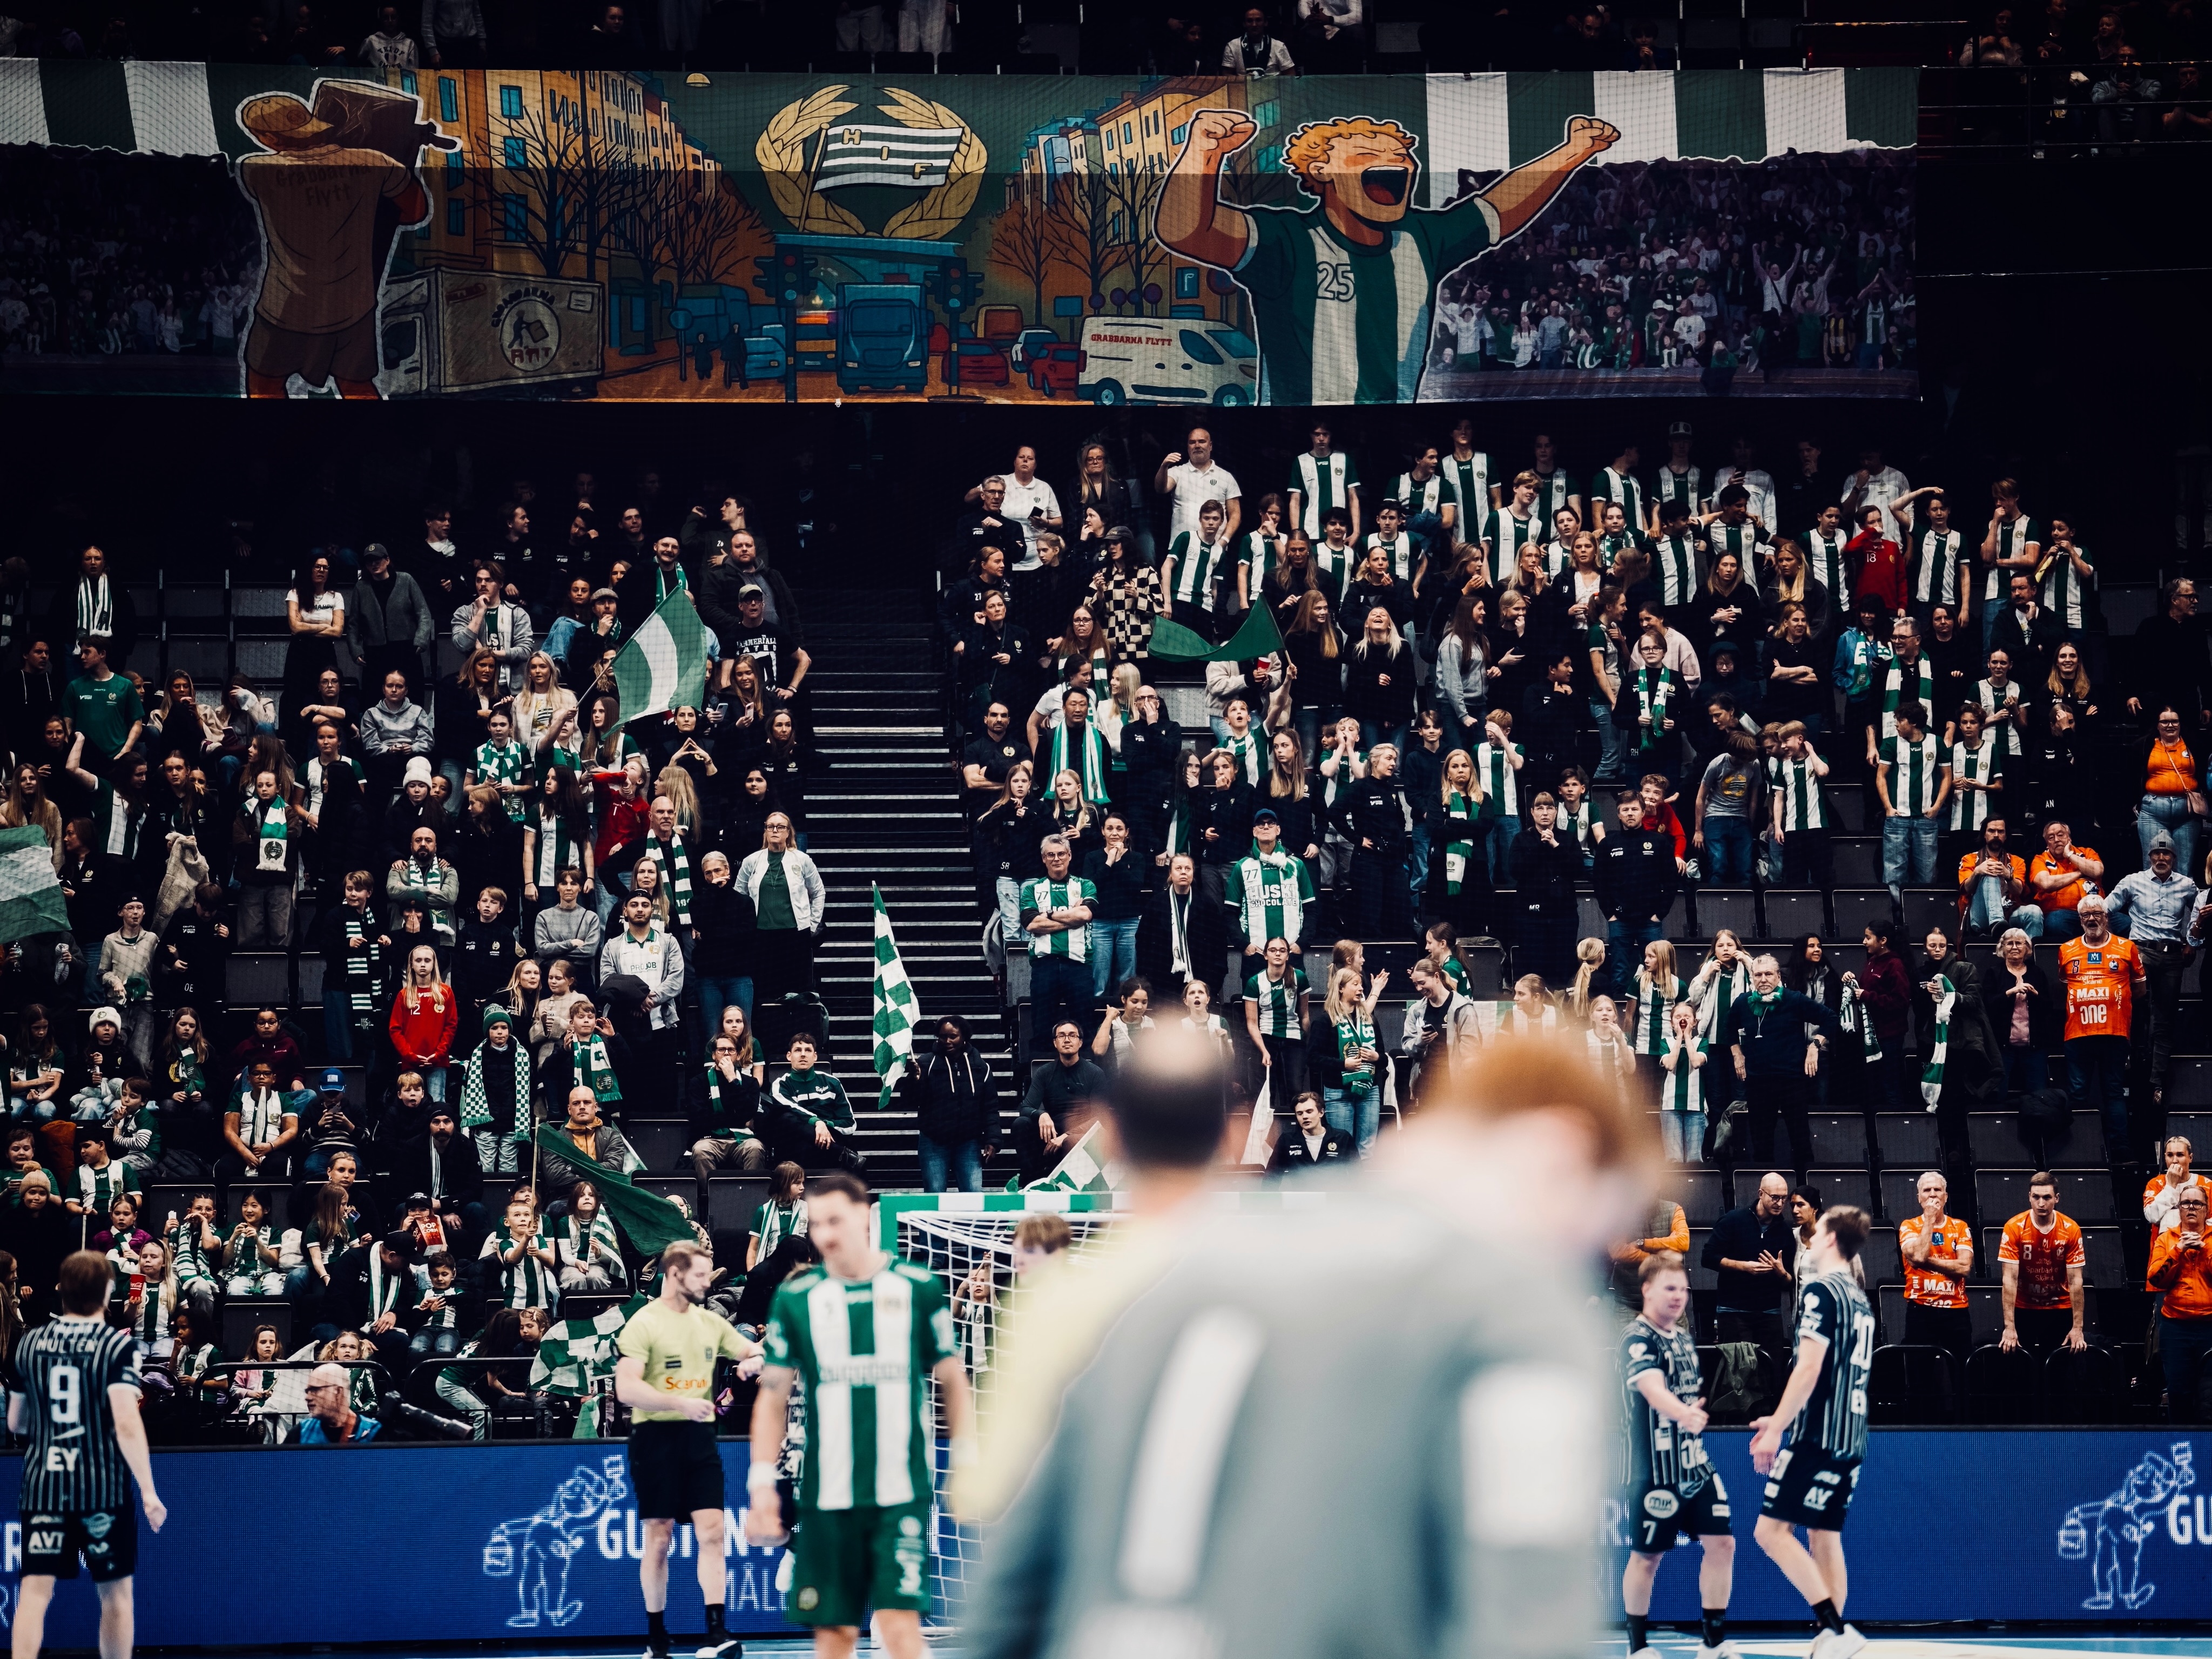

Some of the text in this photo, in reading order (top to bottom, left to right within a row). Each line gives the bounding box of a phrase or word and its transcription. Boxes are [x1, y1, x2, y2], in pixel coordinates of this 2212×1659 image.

[377, 45, 405, 56] TEDDY
[1316, 261, 1355, 302] 25
[1090, 333, 1172, 347] GRABBARNA FLYTT
[1866, 553, 1876, 563] 18
[974, 592, 982, 601] 27
[1630, 748, 1638, 757] RH
[2045, 799, 2054, 808] AN
[1244, 868, 1258, 880] 77
[1036, 891, 1048, 901] 77
[1246, 883, 1297, 899] HUSKI
[1250, 899, 1297, 907] CHOCOLATE
[630, 962, 657, 971] PROJOB
[2072, 959, 2080, 974] 8
[2076, 987, 2109, 998] MAXI
[410, 1003, 420, 1015] 12
[815, 1084, 829, 1093] Bajen
[2022, 1244, 2032, 1260] 8
[1923, 1278, 1955, 1292] MAXI
[49, 1365, 80, 1424] 9
[46, 1447, 80, 1472] EY
[1642, 1520, 1657, 1545] 7
